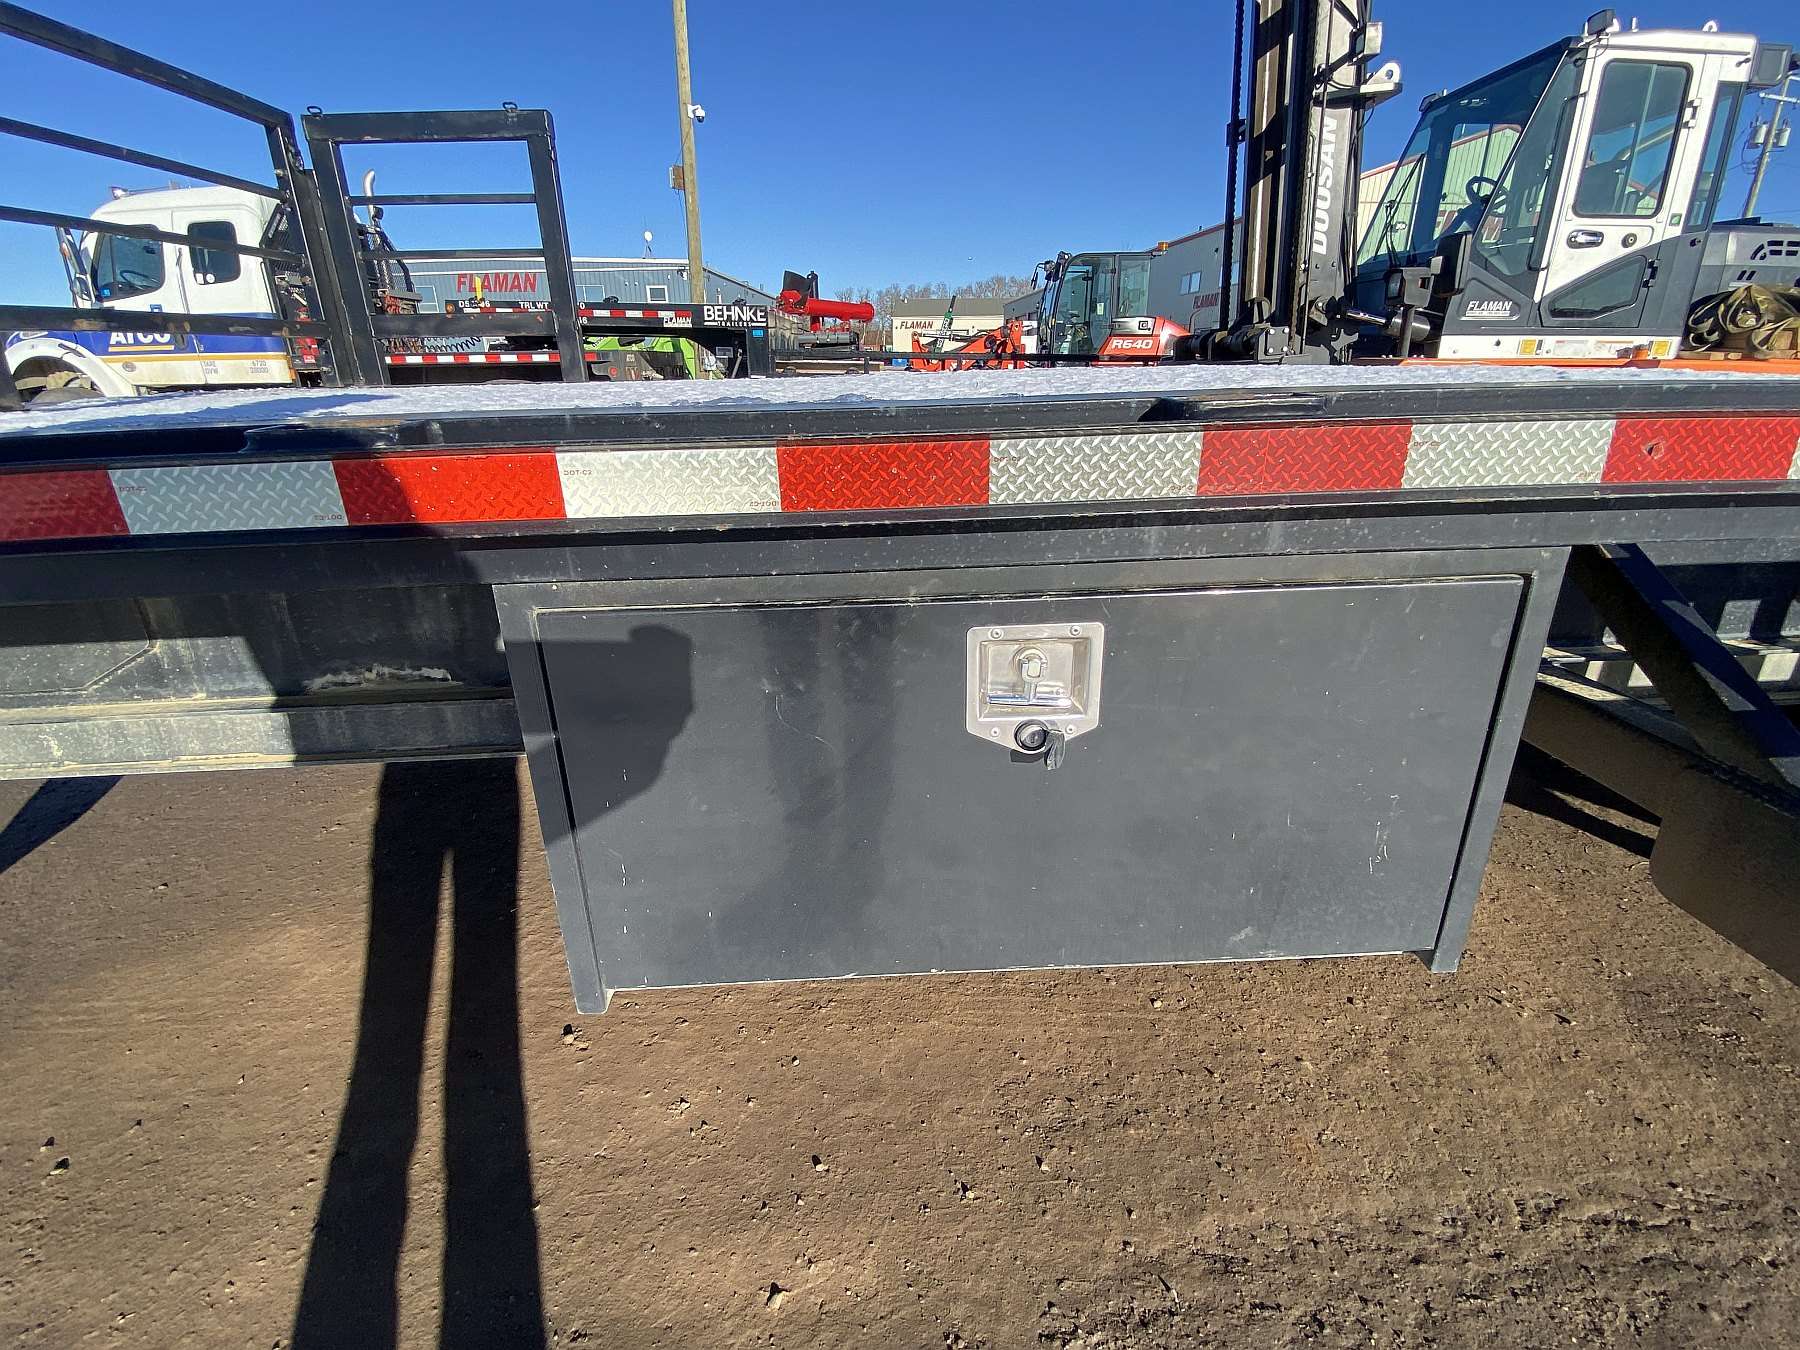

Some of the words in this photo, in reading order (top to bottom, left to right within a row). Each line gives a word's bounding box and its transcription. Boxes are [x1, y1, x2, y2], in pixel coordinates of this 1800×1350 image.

[456, 272, 538, 293] FLAMAN
[1466, 301, 1512, 311] FLAMAN
[703, 305, 767, 321] BEHNKE
[900, 321, 934, 330] FLAMAN
[1111, 340, 1153, 349] R640
